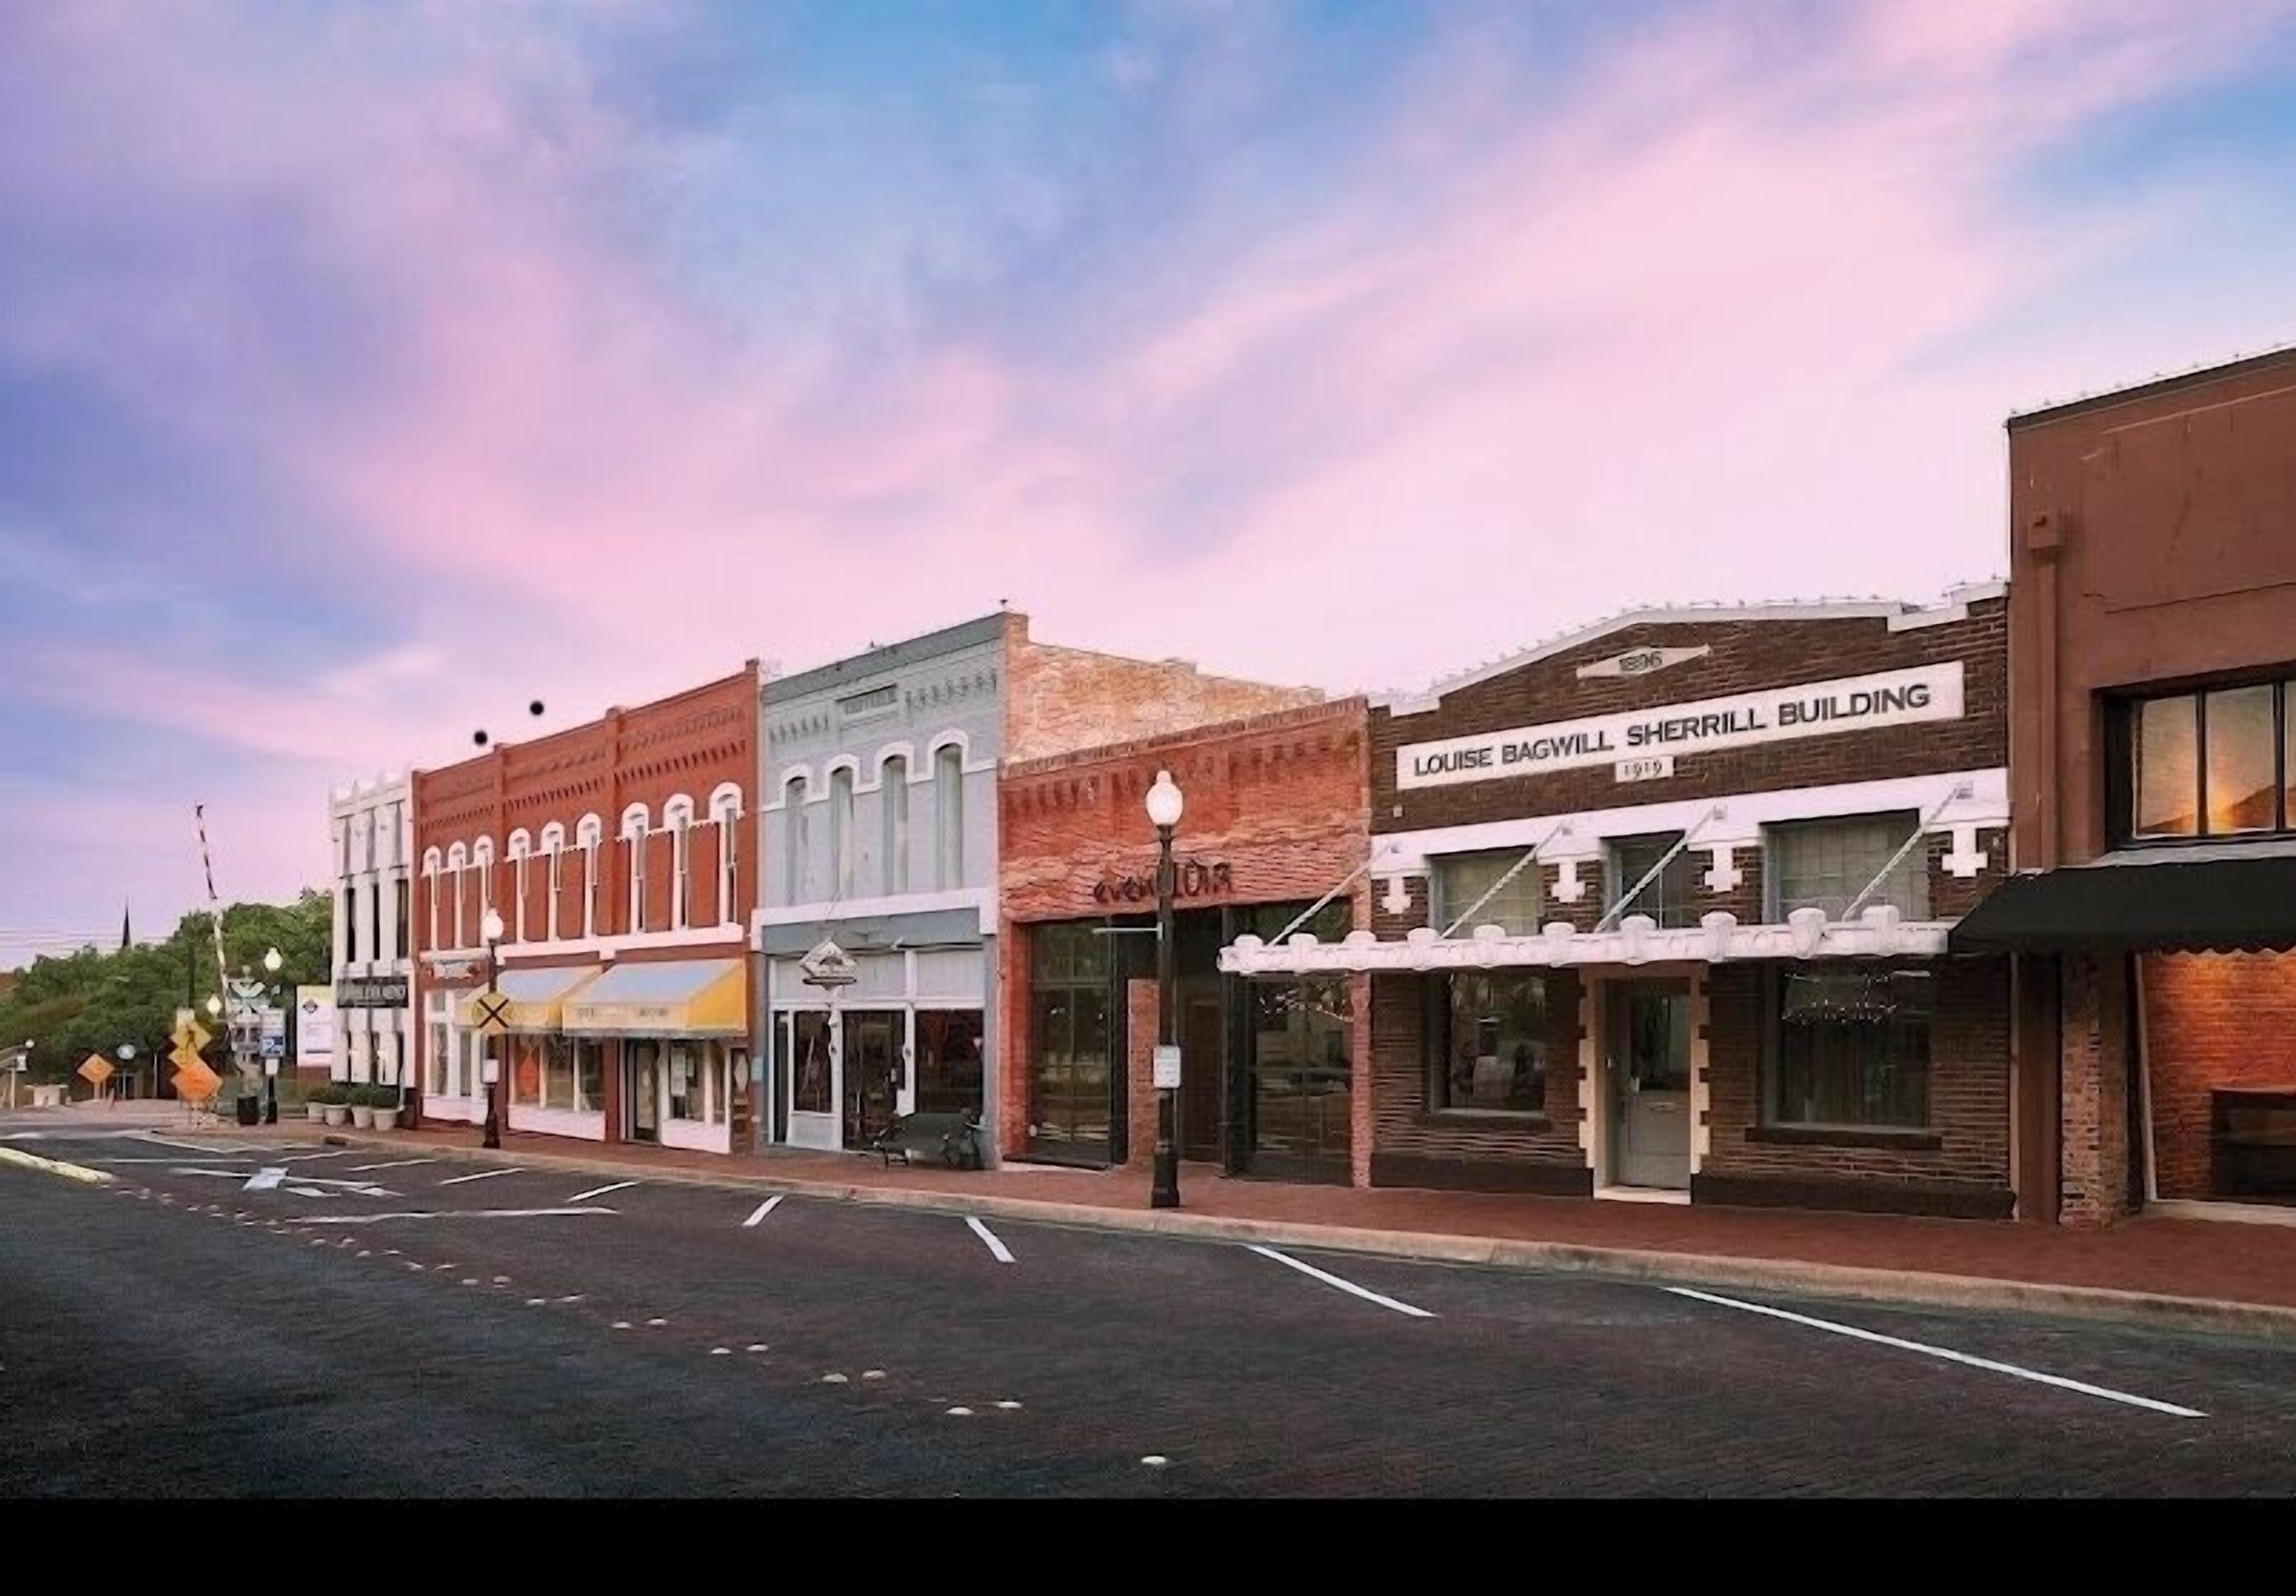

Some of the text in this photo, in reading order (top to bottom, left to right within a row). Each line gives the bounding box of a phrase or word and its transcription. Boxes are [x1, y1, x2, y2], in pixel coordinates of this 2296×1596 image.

[1414, 684, 1931, 777] LOUISE BAGWILL SHERRILL BUILDING
[1624, 760, 1663, 779] 1919
